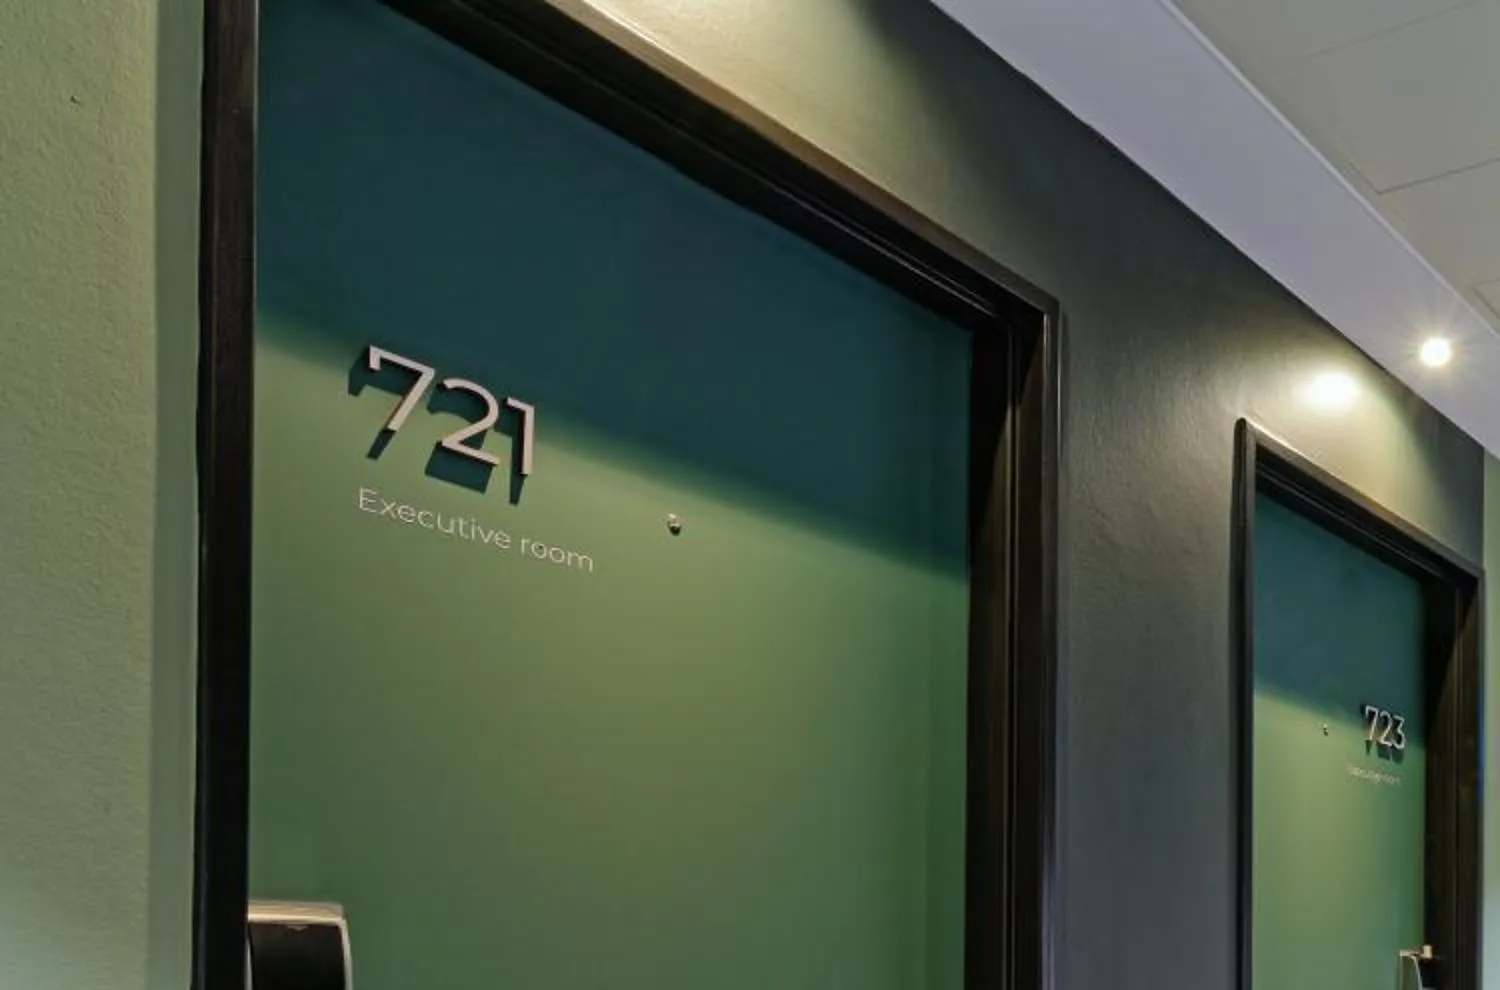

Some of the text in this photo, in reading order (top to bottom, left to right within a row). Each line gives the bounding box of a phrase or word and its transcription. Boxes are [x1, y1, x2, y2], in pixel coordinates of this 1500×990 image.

[369, 345, 535, 474] 721
[358, 487, 594, 572] Executive room
[1365, 705, 1405, 749] 723
